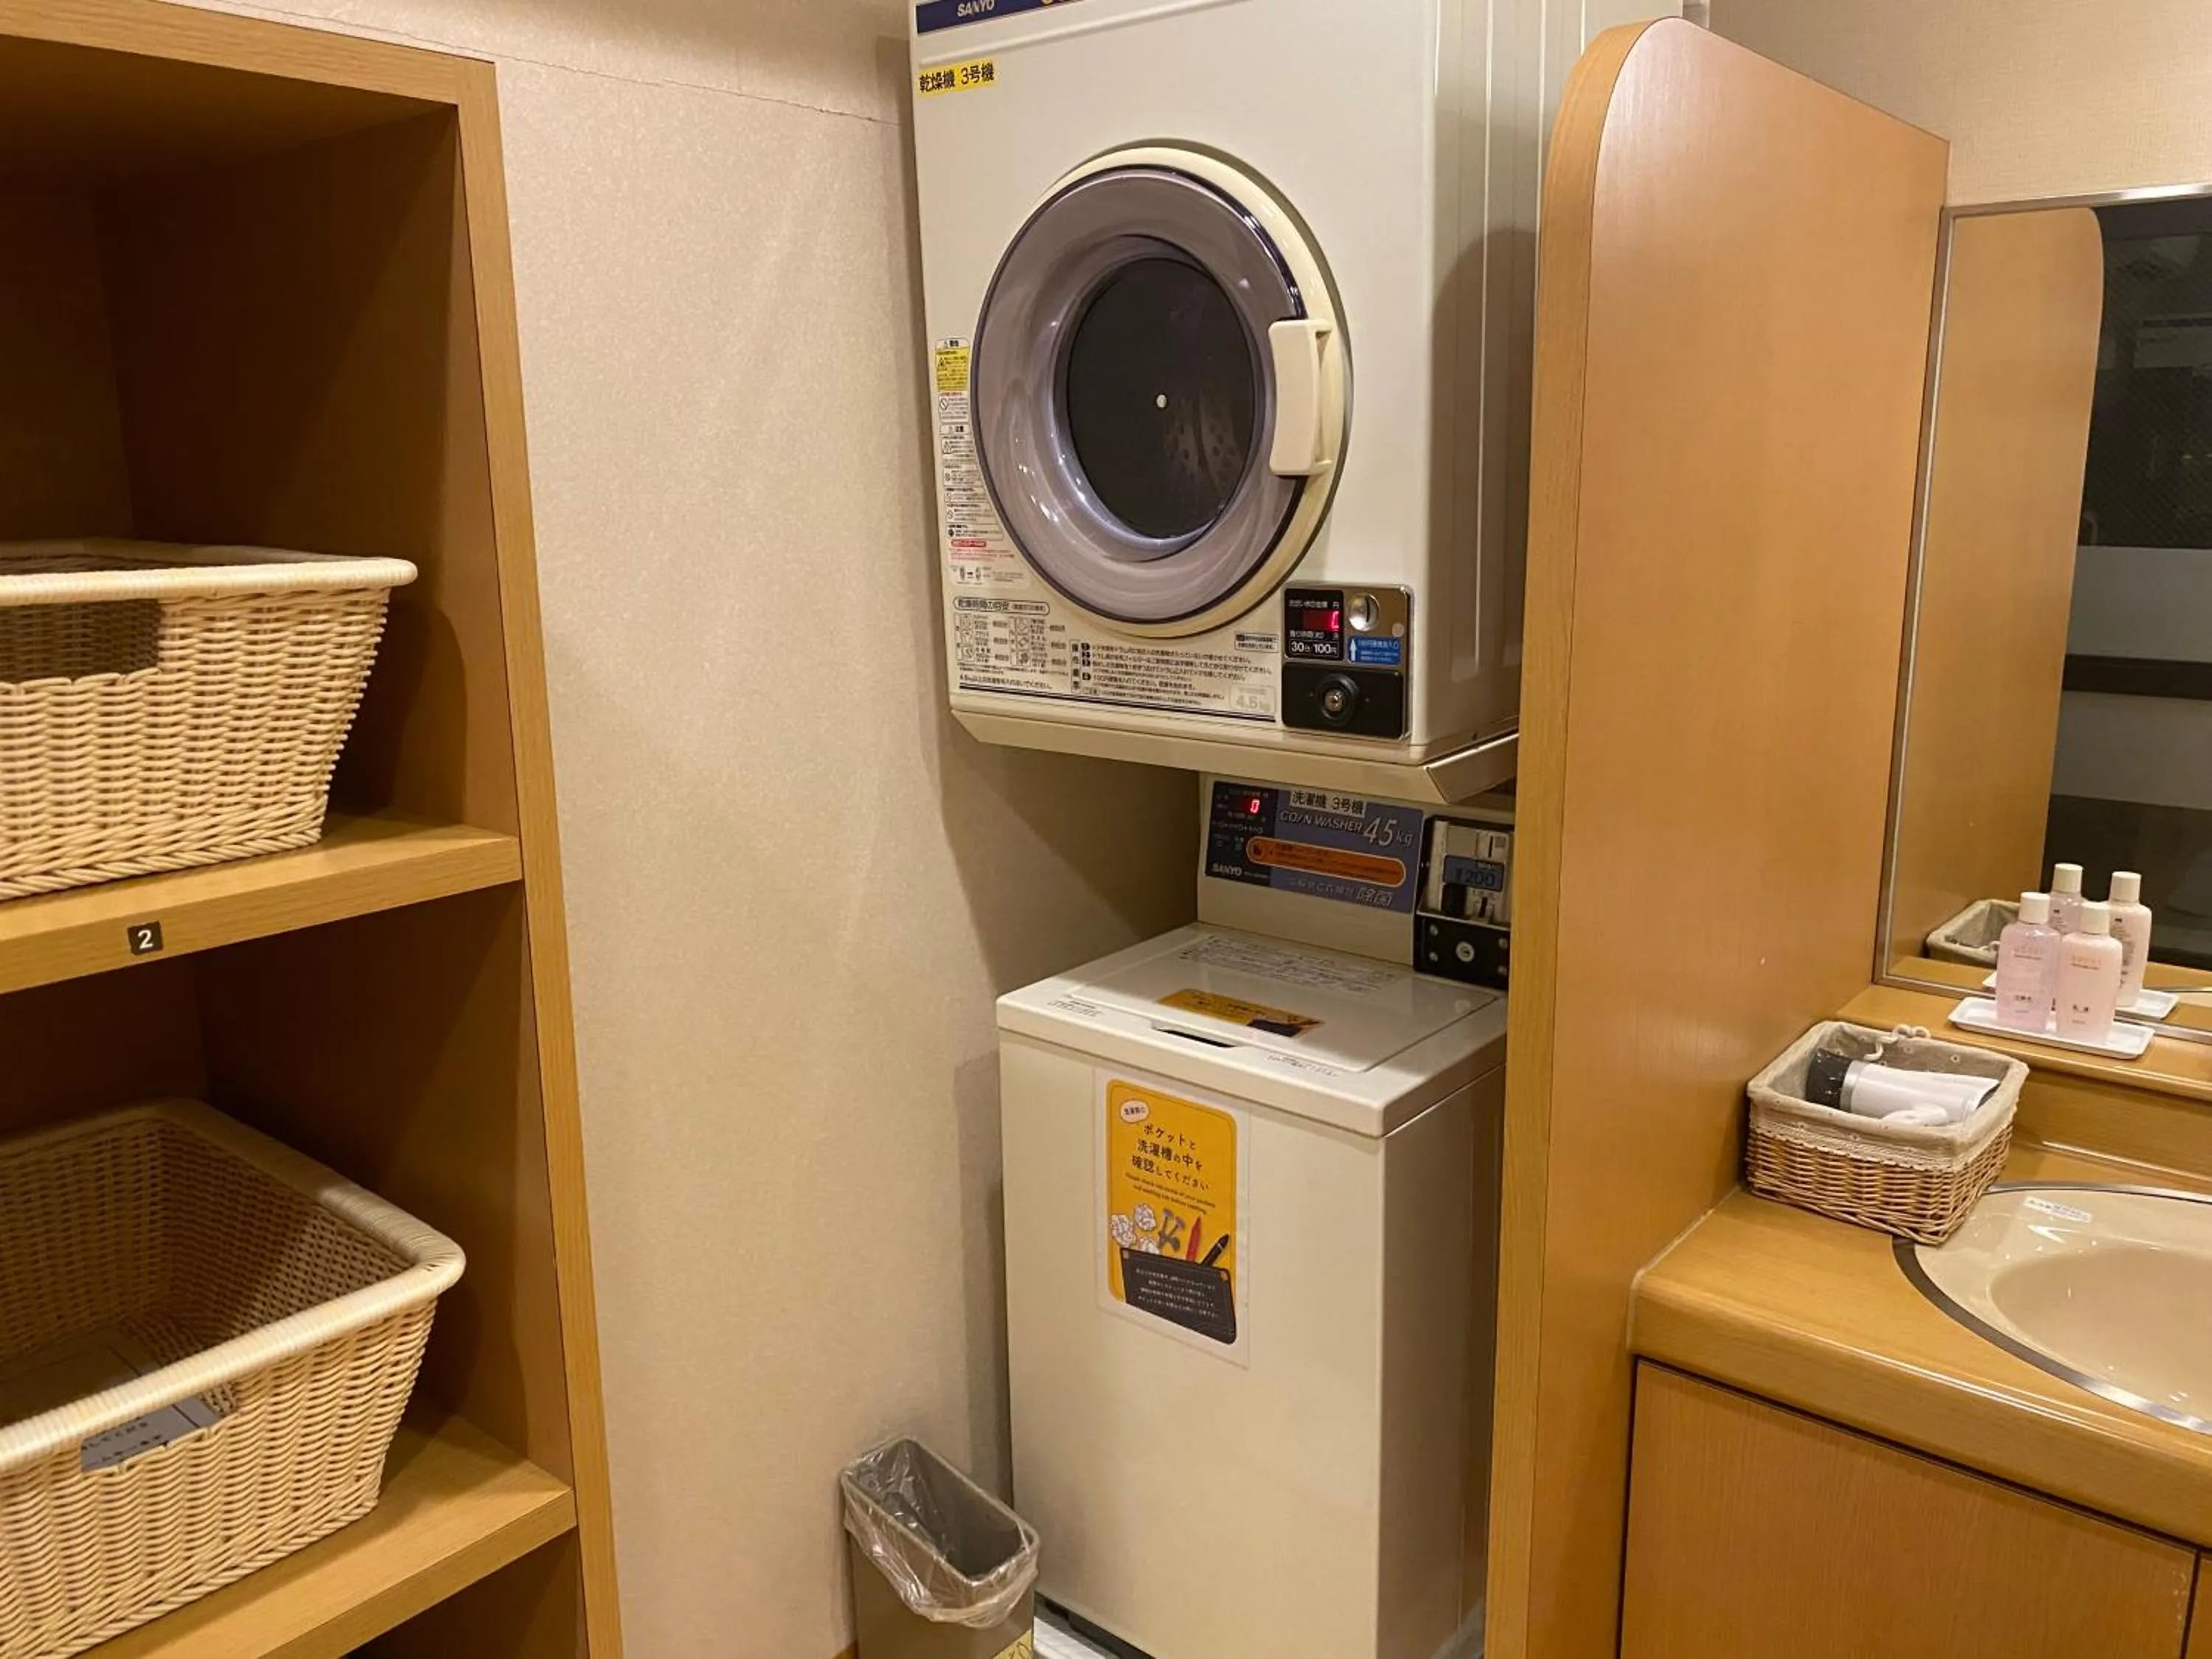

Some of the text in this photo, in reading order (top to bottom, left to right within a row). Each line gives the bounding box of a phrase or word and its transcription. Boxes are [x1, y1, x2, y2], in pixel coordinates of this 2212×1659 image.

[957, 0, 995, 17] SANYO
[961, 62, 995, 86] 3号機
[1250, 799, 1261, 814] 0
[1291, 790, 1327, 809] 洗濯機
[1332, 797, 1364, 815] 3号機
[138, 929, 153, 950] 2
[1144, 1123, 1196, 1151] ポケットと
[1132, 1154, 1209, 1191] 確認してください
